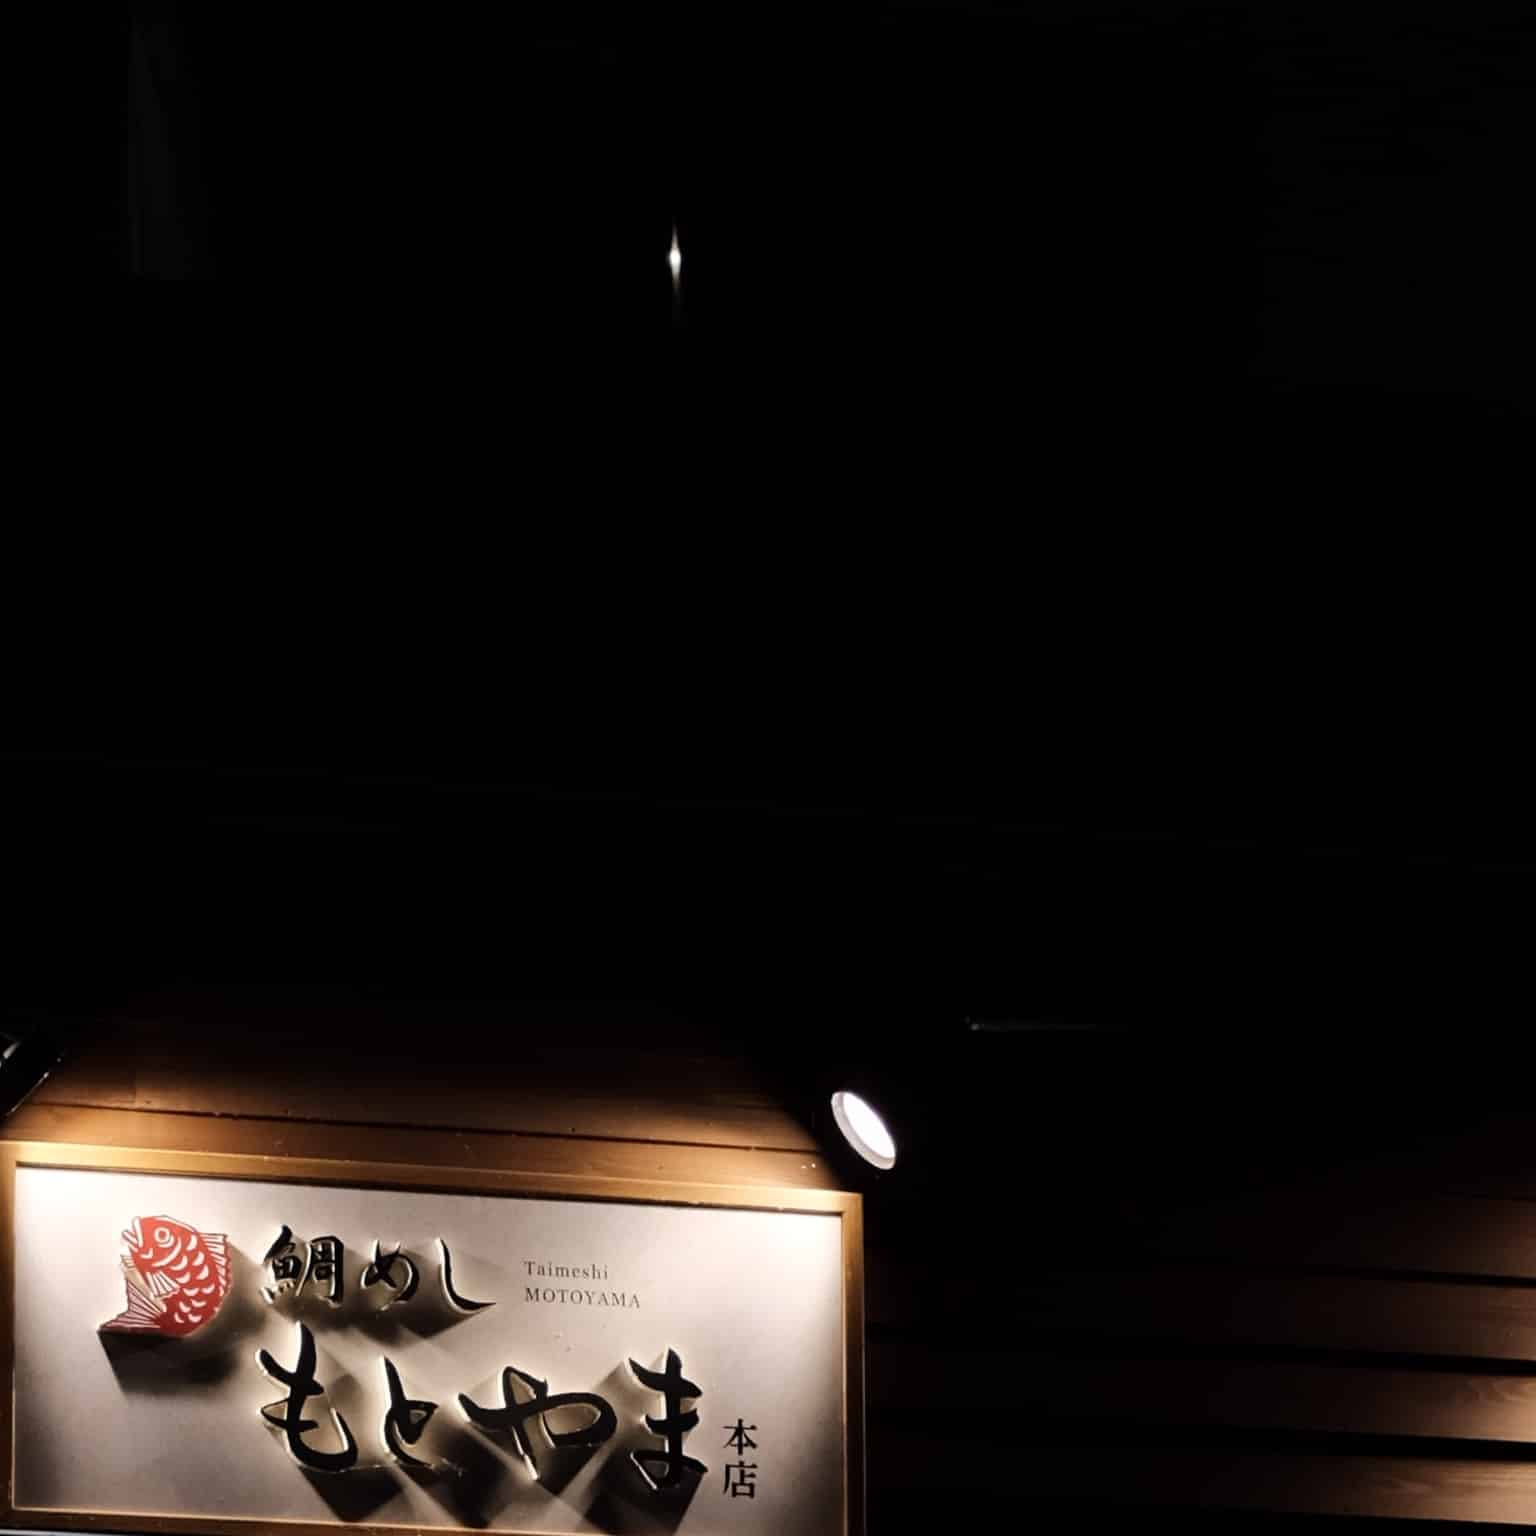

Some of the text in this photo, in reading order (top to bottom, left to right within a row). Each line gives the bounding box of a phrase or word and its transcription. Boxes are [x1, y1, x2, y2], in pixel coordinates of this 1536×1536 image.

[263, 1225, 498, 1316] 鯛めし
[524, 1261, 609, 1281] Taimeshi
[524, 1287, 641, 1309] MOTOYAMA
[260, 1322, 709, 1496] もとやま
[722, 1418, 758, 1498] 本店
